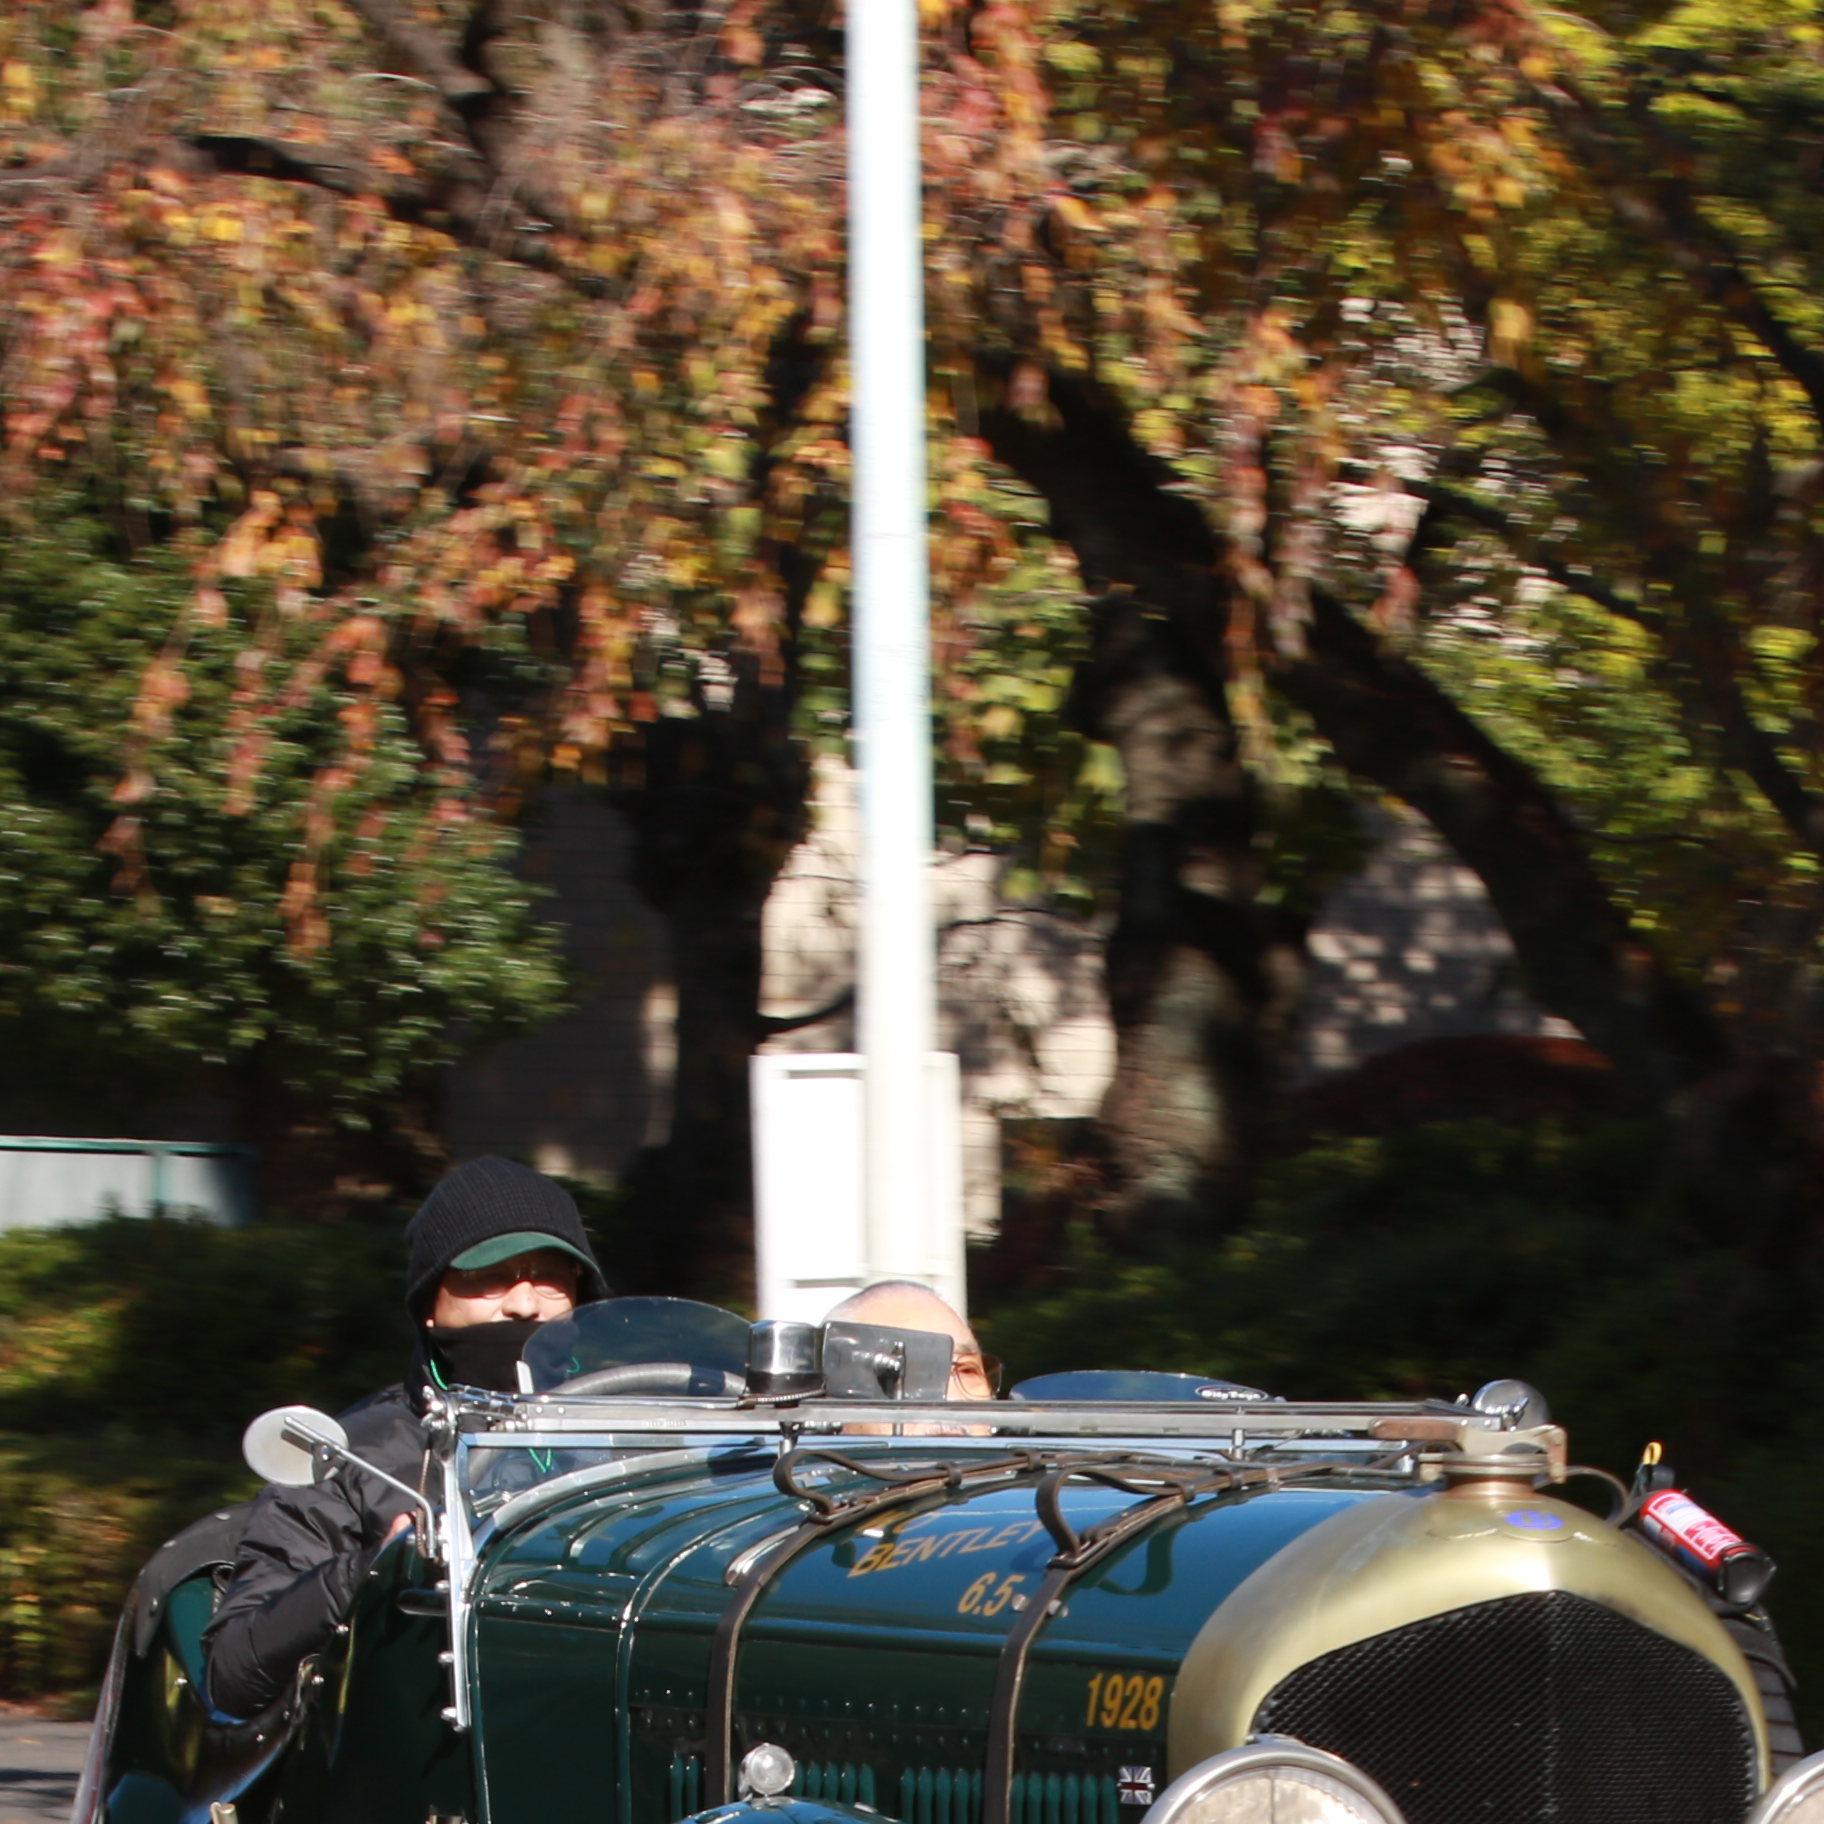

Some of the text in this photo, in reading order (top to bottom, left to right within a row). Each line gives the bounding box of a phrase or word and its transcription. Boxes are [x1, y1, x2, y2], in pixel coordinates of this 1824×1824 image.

[846, 1520, 1044, 1578] BENTLEY
[957, 1572, 1026, 1617] 6.5
[1086, 1672, 1165, 1731] 1928
